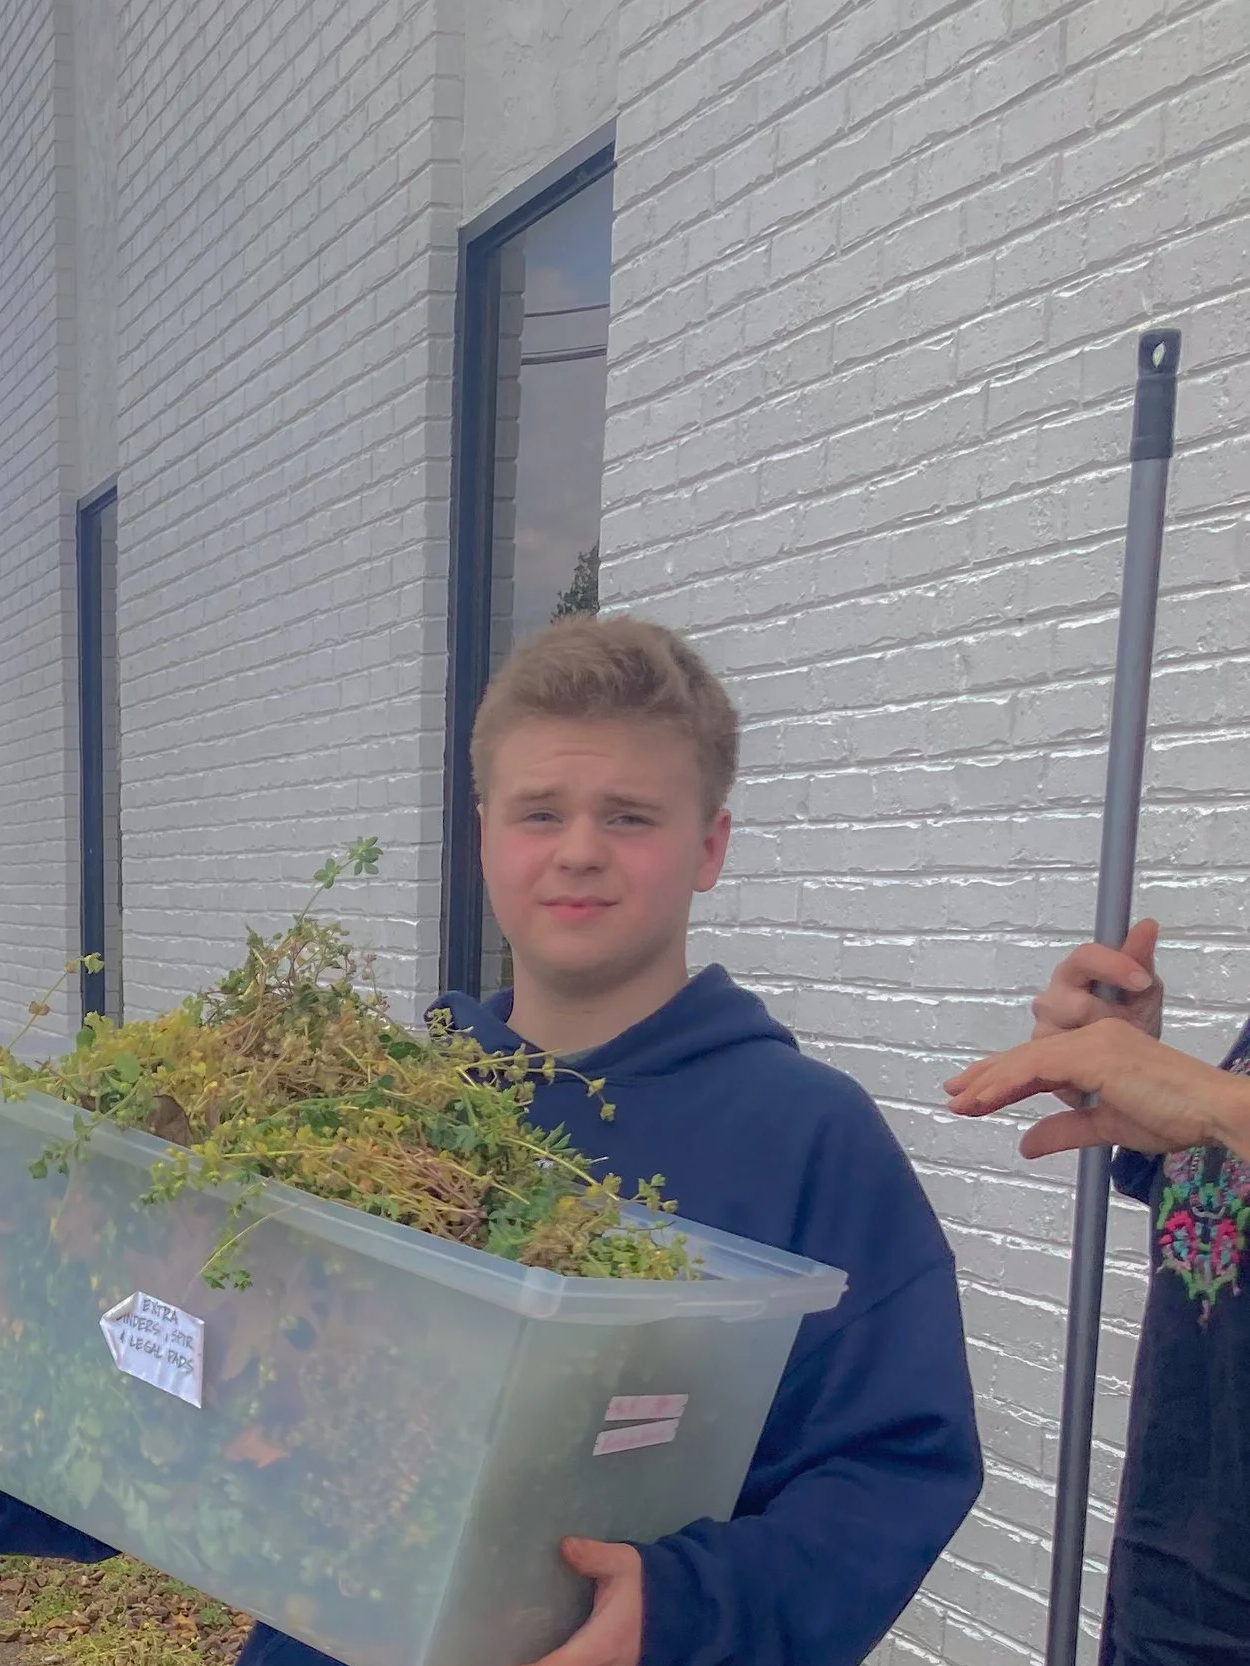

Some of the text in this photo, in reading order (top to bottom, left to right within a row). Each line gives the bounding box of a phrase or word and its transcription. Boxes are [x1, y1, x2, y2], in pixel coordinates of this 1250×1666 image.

[142, 1299, 178, 1324] EXTRA
[129, 1335, 162, 1359] LEGAL
[167, 1350, 195, 1374] PADS
